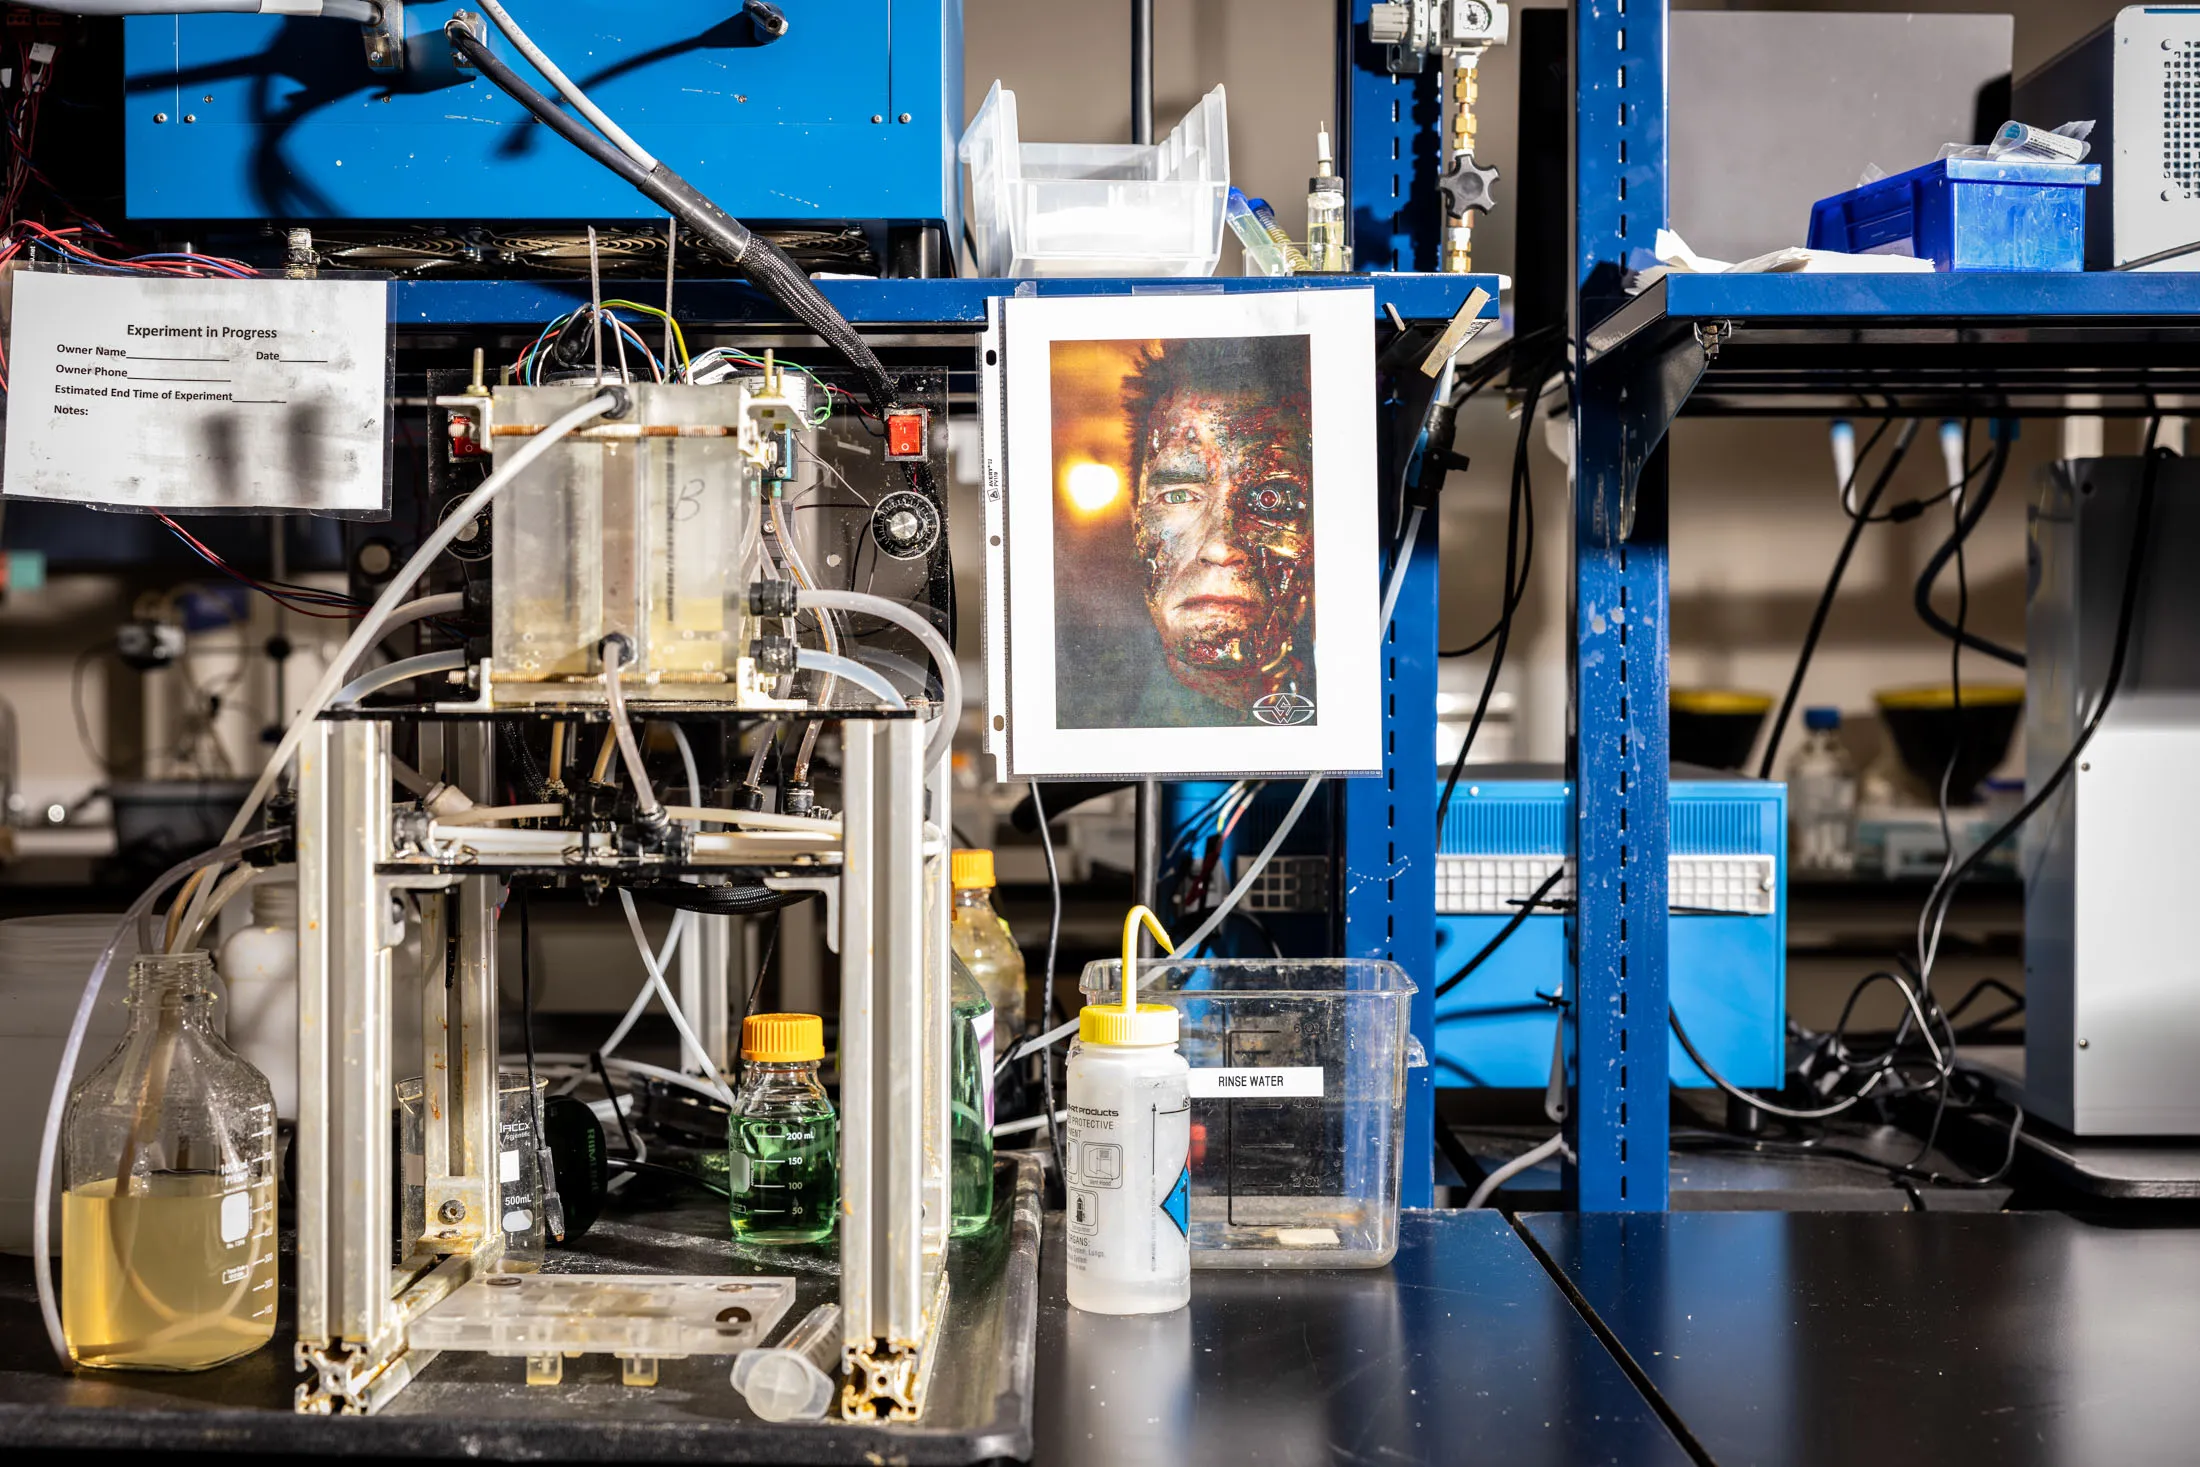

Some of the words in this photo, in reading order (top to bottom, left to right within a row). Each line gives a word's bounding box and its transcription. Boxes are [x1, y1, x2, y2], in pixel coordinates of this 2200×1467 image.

[127, 324, 202, 339] Experiment
[206, 326, 218, 338] in
[222, 326, 277, 340] Progress
[56, 344, 93, 355] Owner
[95, 346, 126, 357] Name
[256, 351, 280, 361] Date
[55, 364, 92, 375] Owner
[94, 366, 128, 378] Phone
[55, 384, 108, 397] Estimated
[111, 388, 130, 398] End
[133, 389, 159, 399] Time
[161, 390, 173, 400] of
[174, 390, 233, 402] Experiment
[54, 404, 89, 416] Notes:
[673, 478, 706, 522] B
[1218, 1075, 1247, 1087] RINSE
[1249, 1075, 1284, 1087] WATER
[1072, 1116, 1114, 1130] PROTECTIVE
[786, 1132, 803, 1141] 200
[803, 1131, 814, 1139] mL
[788, 1157, 803, 1165] 150
[788, 1182, 803, 1190] 100
[504, 1194, 532, 1206] 500mL
[791, 1206, 803, 1215] 50
